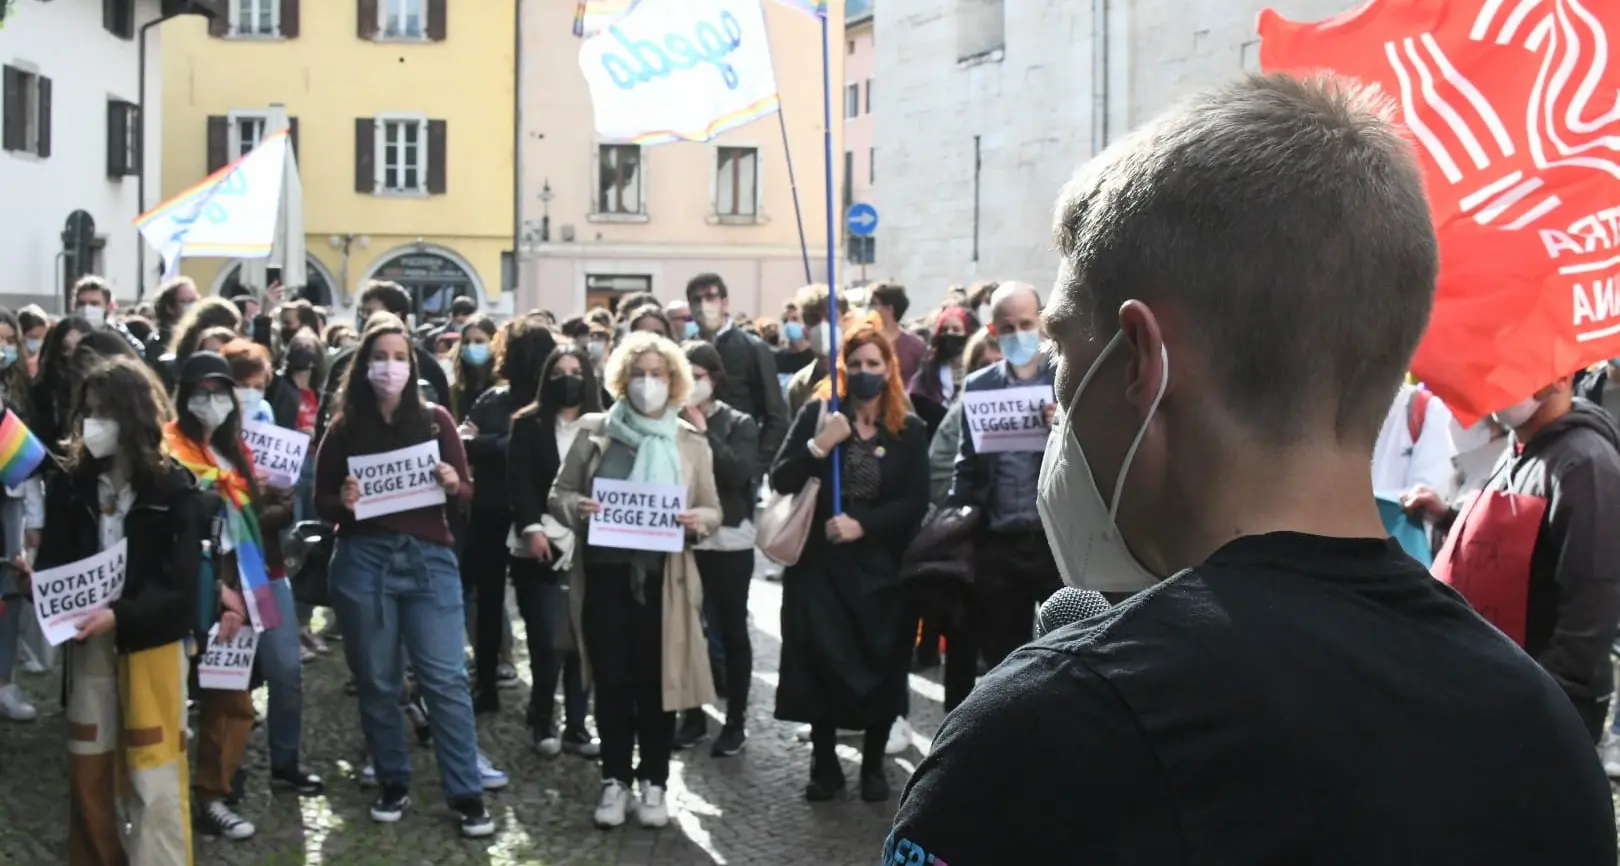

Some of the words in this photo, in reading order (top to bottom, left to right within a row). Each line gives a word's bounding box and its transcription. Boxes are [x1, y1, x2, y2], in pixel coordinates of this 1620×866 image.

[968, 400, 1025, 416] VOTATE
[971, 415, 1019, 432] LEGGE
[239, 428, 281, 452] OTATE
[286, 442, 301, 457] LA
[270, 455, 299, 473] ZAN
[353, 458, 413, 481] VOTATE
[417, 453, 437, 469] LA
[360, 475, 404, 497] EGGE
[596, 490, 657, 508] VOTATE
[661, 496, 681, 510] LA
[37, 563, 105, 598] VOTATE
[109, 552, 125, 574] LA
[39, 587, 97, 619] LEGGE
[237, 636, 253, 650] LA
[223, 651, 250, 669] ZAN
